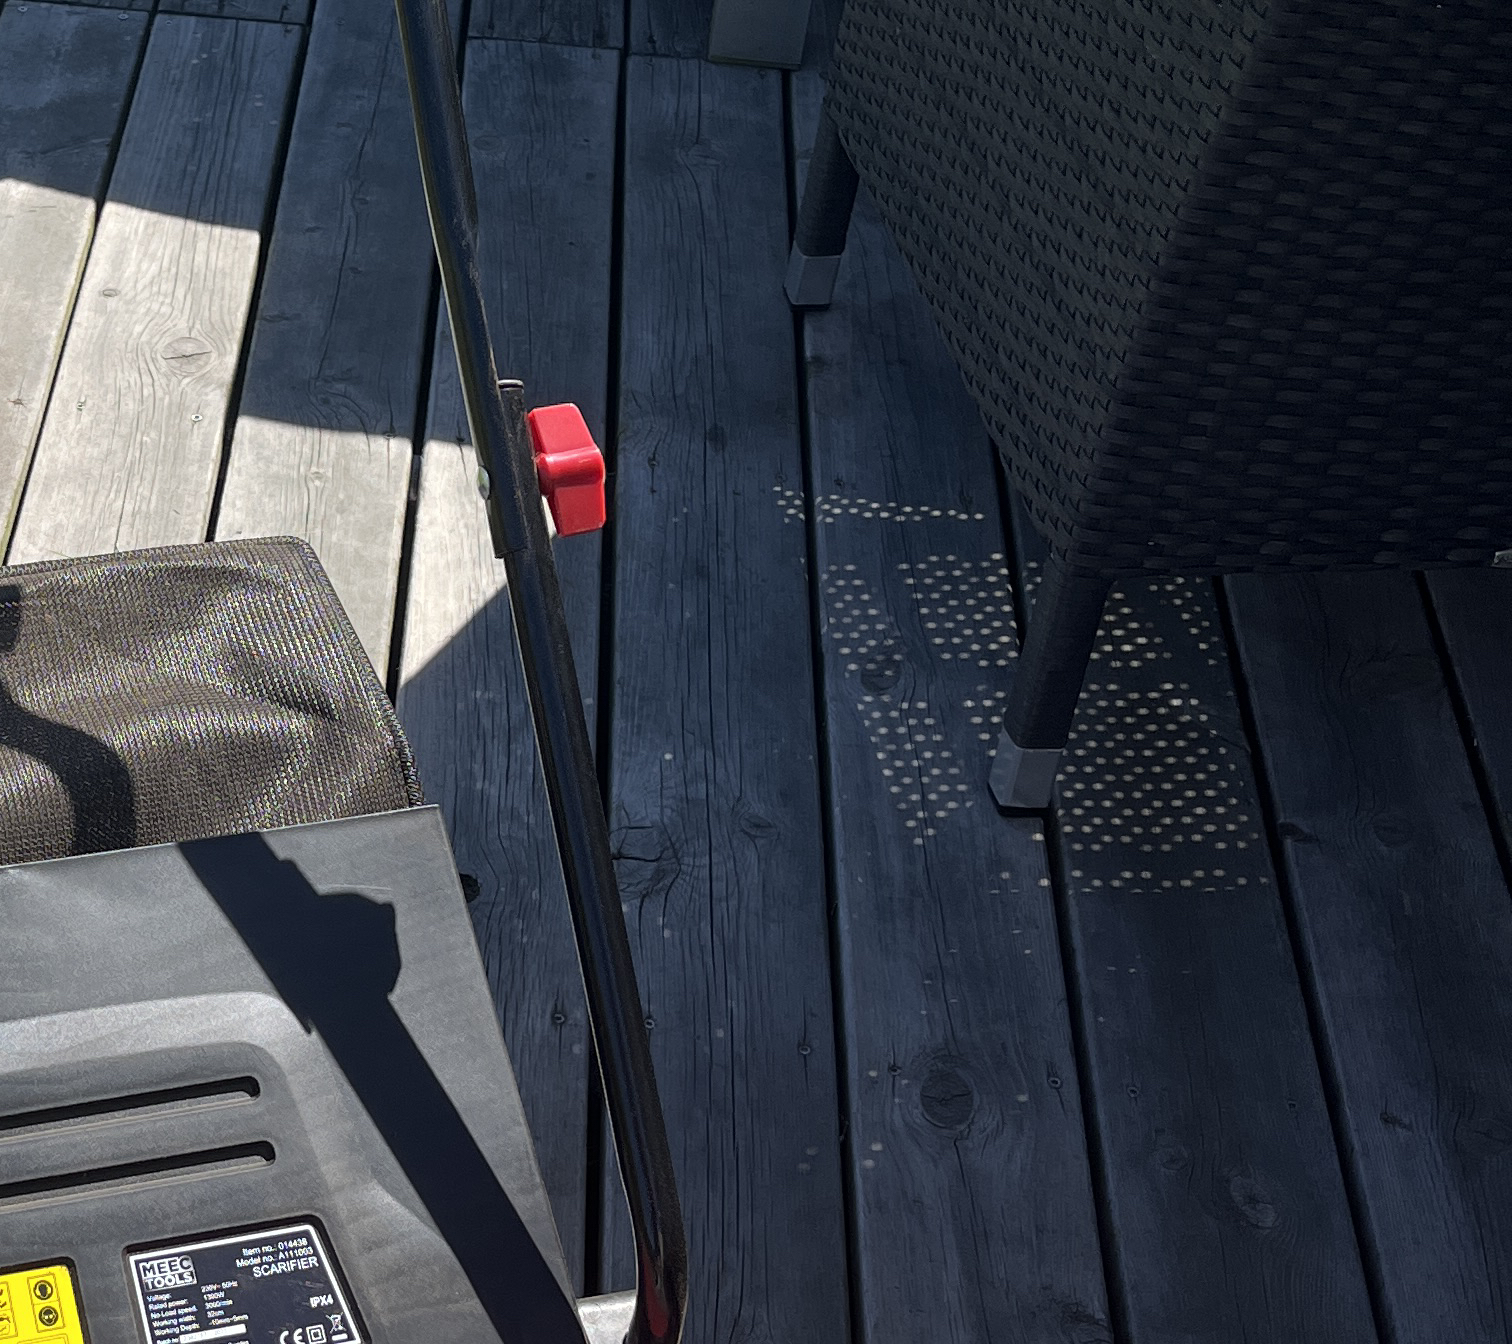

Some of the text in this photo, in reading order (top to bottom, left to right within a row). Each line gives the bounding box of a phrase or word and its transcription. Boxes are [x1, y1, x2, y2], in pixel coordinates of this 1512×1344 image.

[242, 1247, 261, 1256] Item
[278, 1238, 308, 1250] 014438
[140, 1256, 192, 1277] MEEC
[236, 1256, 261, 1268] Model
[253, 1256, 319, 1277] SCARIFIER
[146, 1272, 193, 1290] TOOLS
[310, 1294, 334, 1308] IPX4
